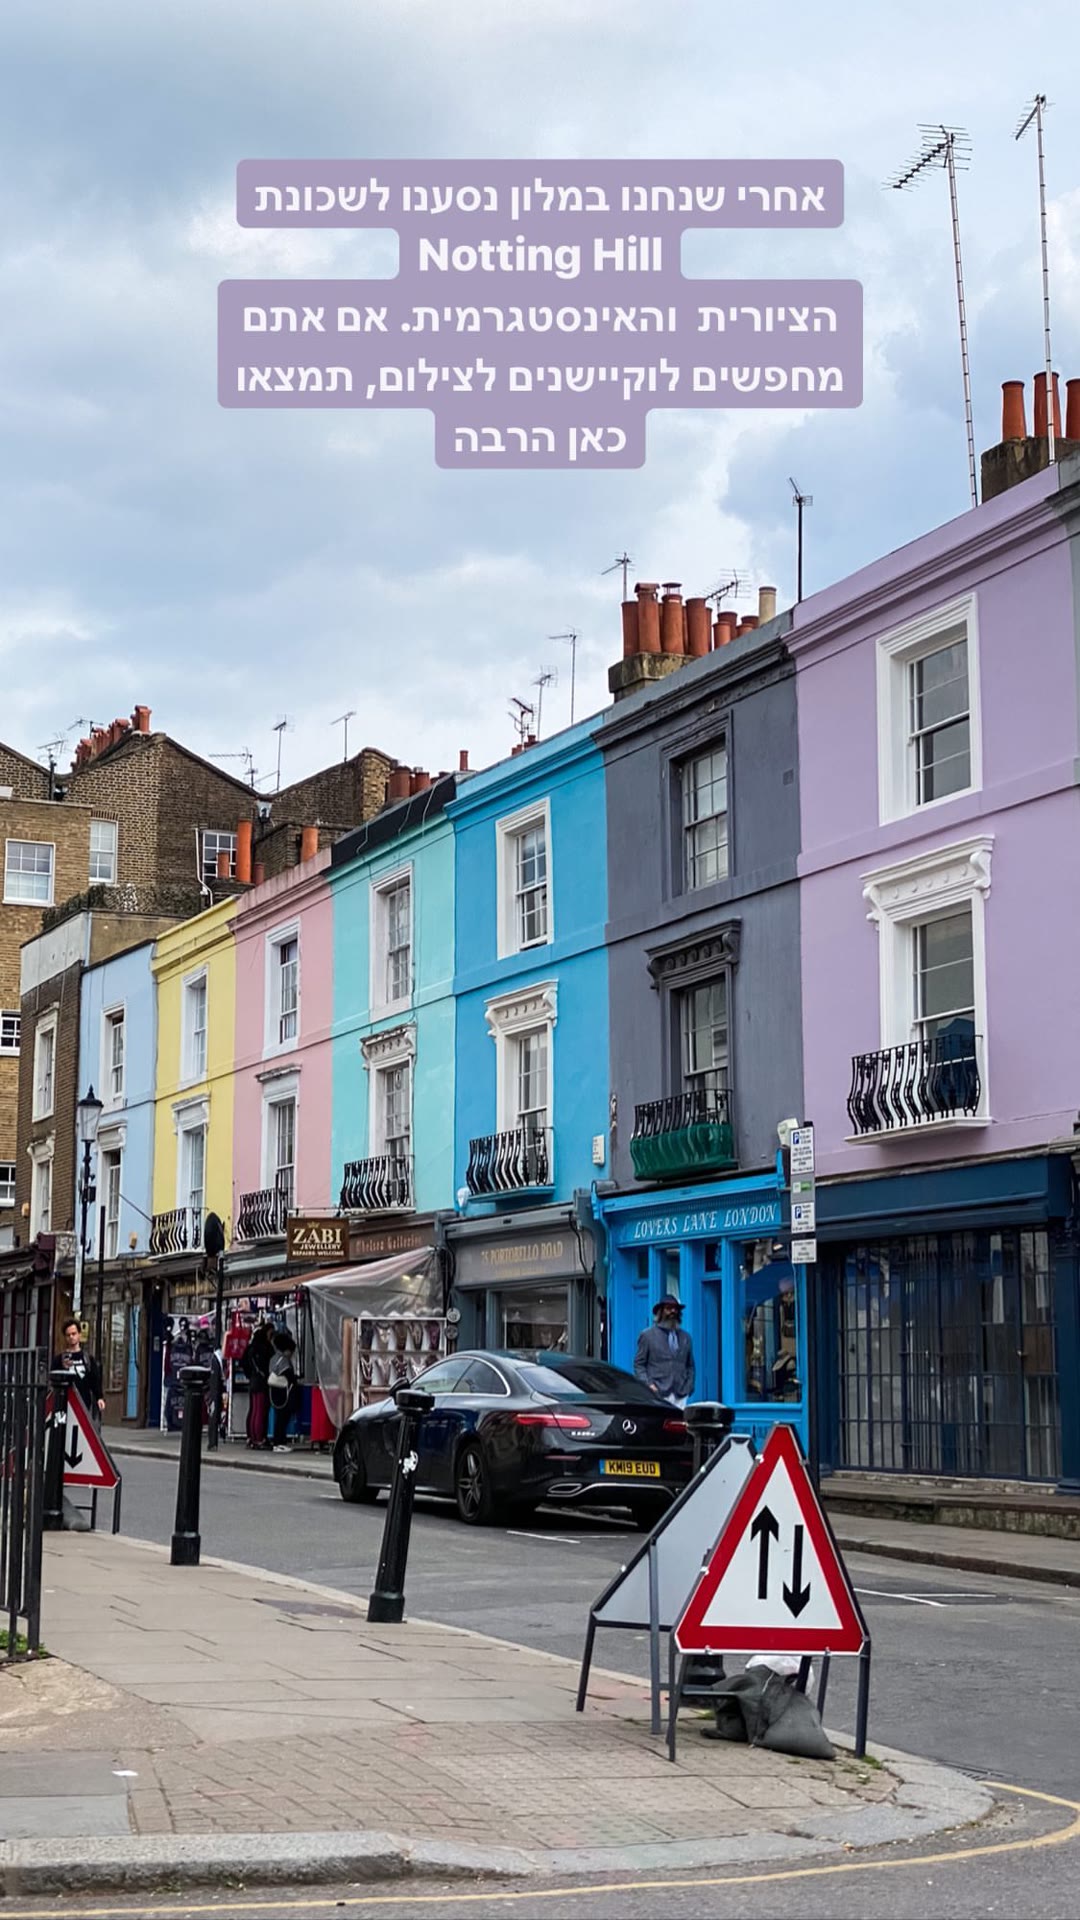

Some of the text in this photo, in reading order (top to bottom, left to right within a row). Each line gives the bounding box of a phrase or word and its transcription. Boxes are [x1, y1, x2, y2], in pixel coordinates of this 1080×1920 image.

[634, 1217, 678, 1239] LOVERS
[682, 1211, 718, 1233] LANE
[724, 1204, 777, 1228] LONDON
[293, 1228, 342, 1243] ZABI
[490, 1243, 539, 1265] PORTOBELLO
[541, 1240, 564, 1260] ROAD
[608, 1461, 656, 1475] KM19 EUD
